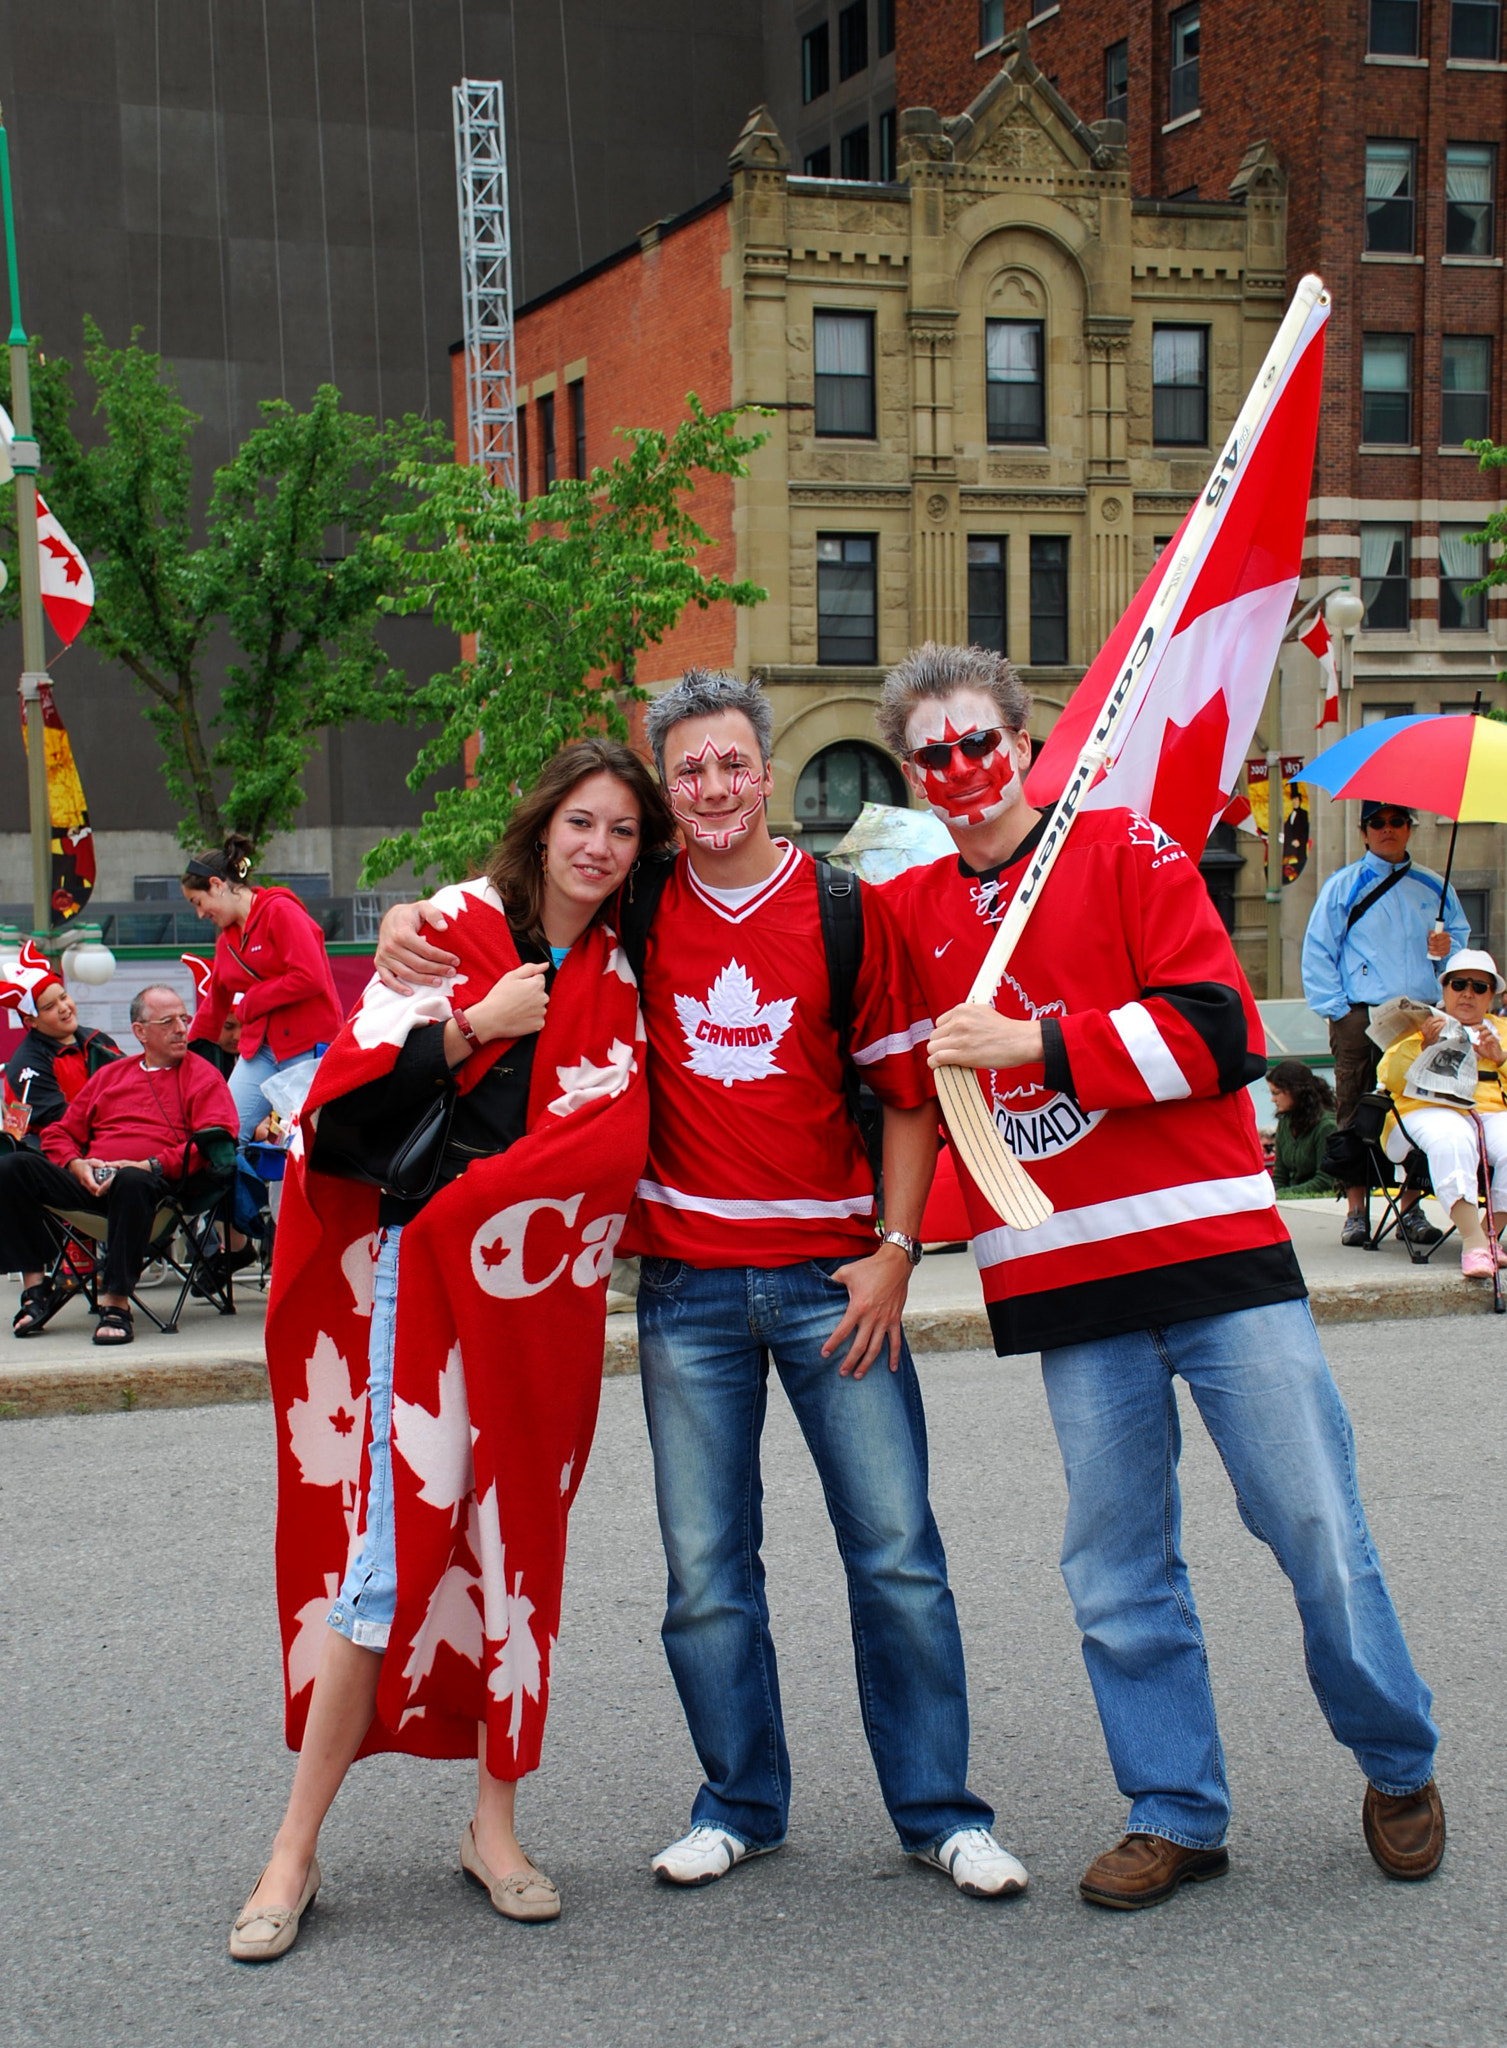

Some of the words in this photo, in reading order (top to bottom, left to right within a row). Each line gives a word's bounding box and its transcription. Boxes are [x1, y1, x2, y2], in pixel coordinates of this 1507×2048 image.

[1206, 439, 1238, 508] 45
[1020, 626, 1155, 904] Candien
[1250, 765, 1268, 777] 2007
[695, 1019, 773, 1047] CANADA
